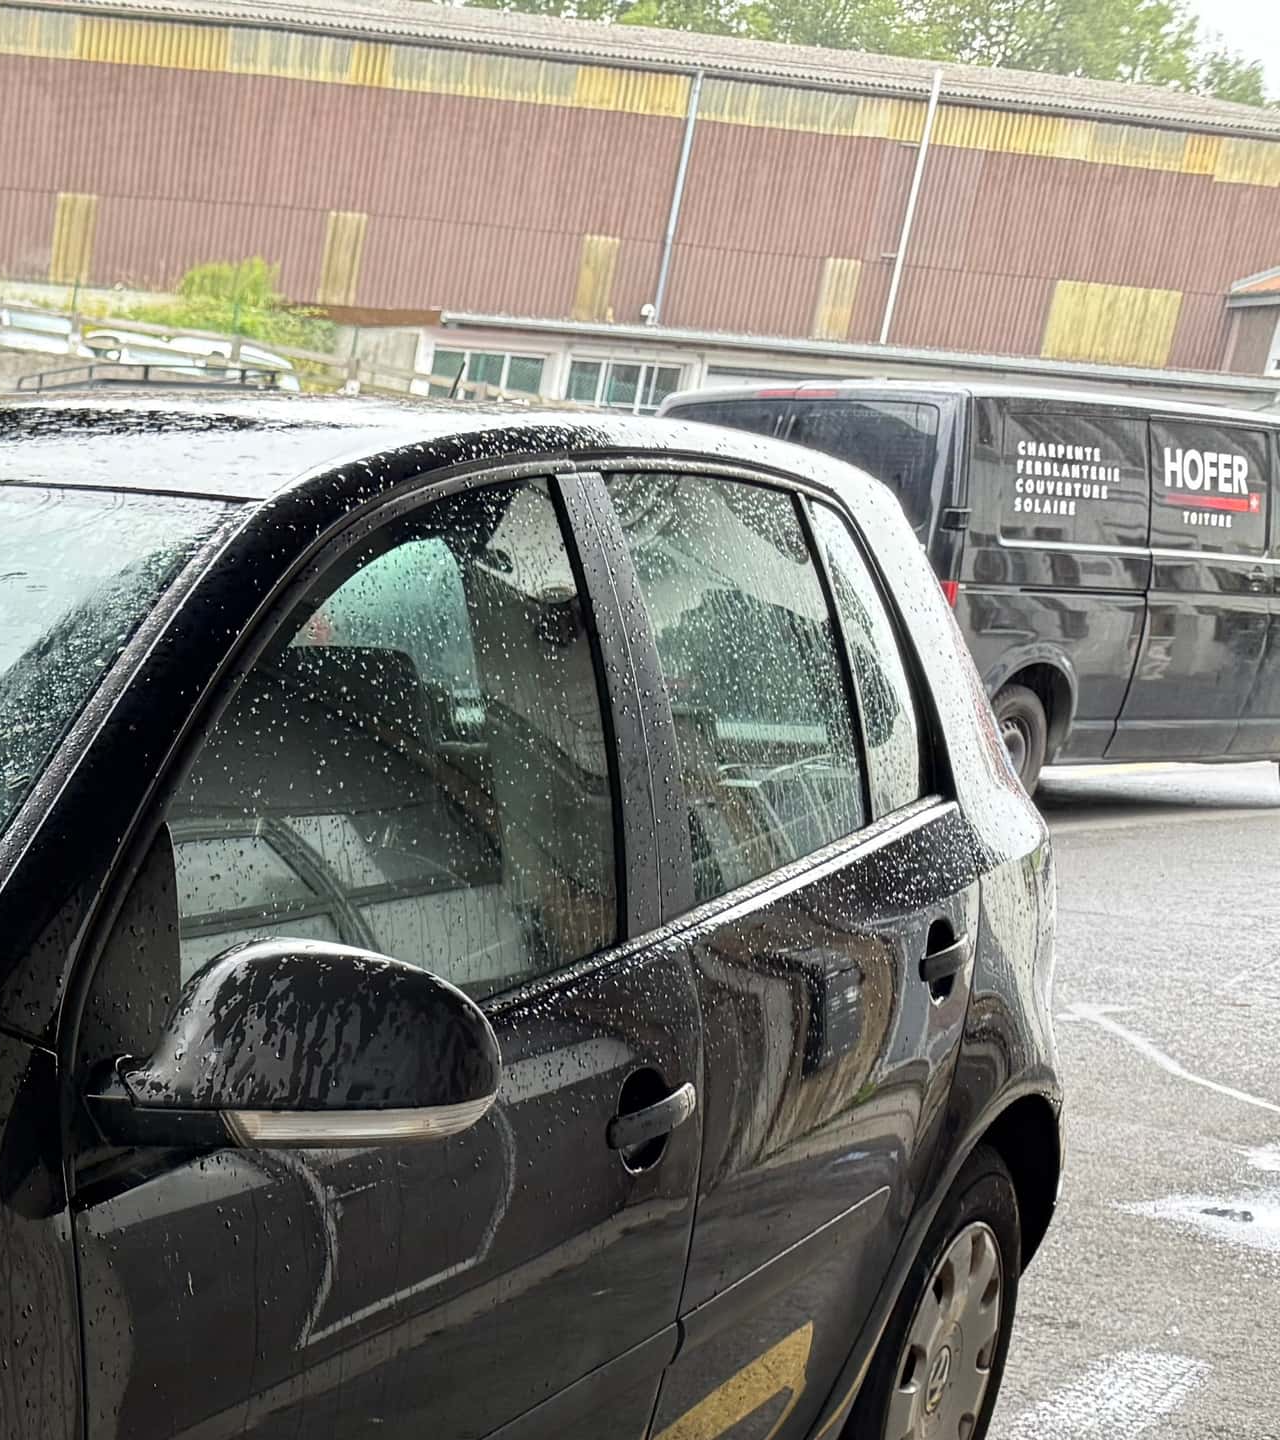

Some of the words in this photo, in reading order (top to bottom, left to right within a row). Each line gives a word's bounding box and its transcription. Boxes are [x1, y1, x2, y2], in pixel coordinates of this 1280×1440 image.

[1017, 440, 1100, 462] CHARPENTE
[1017, 459, 1120, 482] FERBLANTERIE
[1164, 447, 1249, 495] HOFER
[1015, 478, 1108, 499] COUVERTURE
[1014, 497, 1076, 516] SOLAIRE
[1183, 511, 1232, 528] TOITURE
